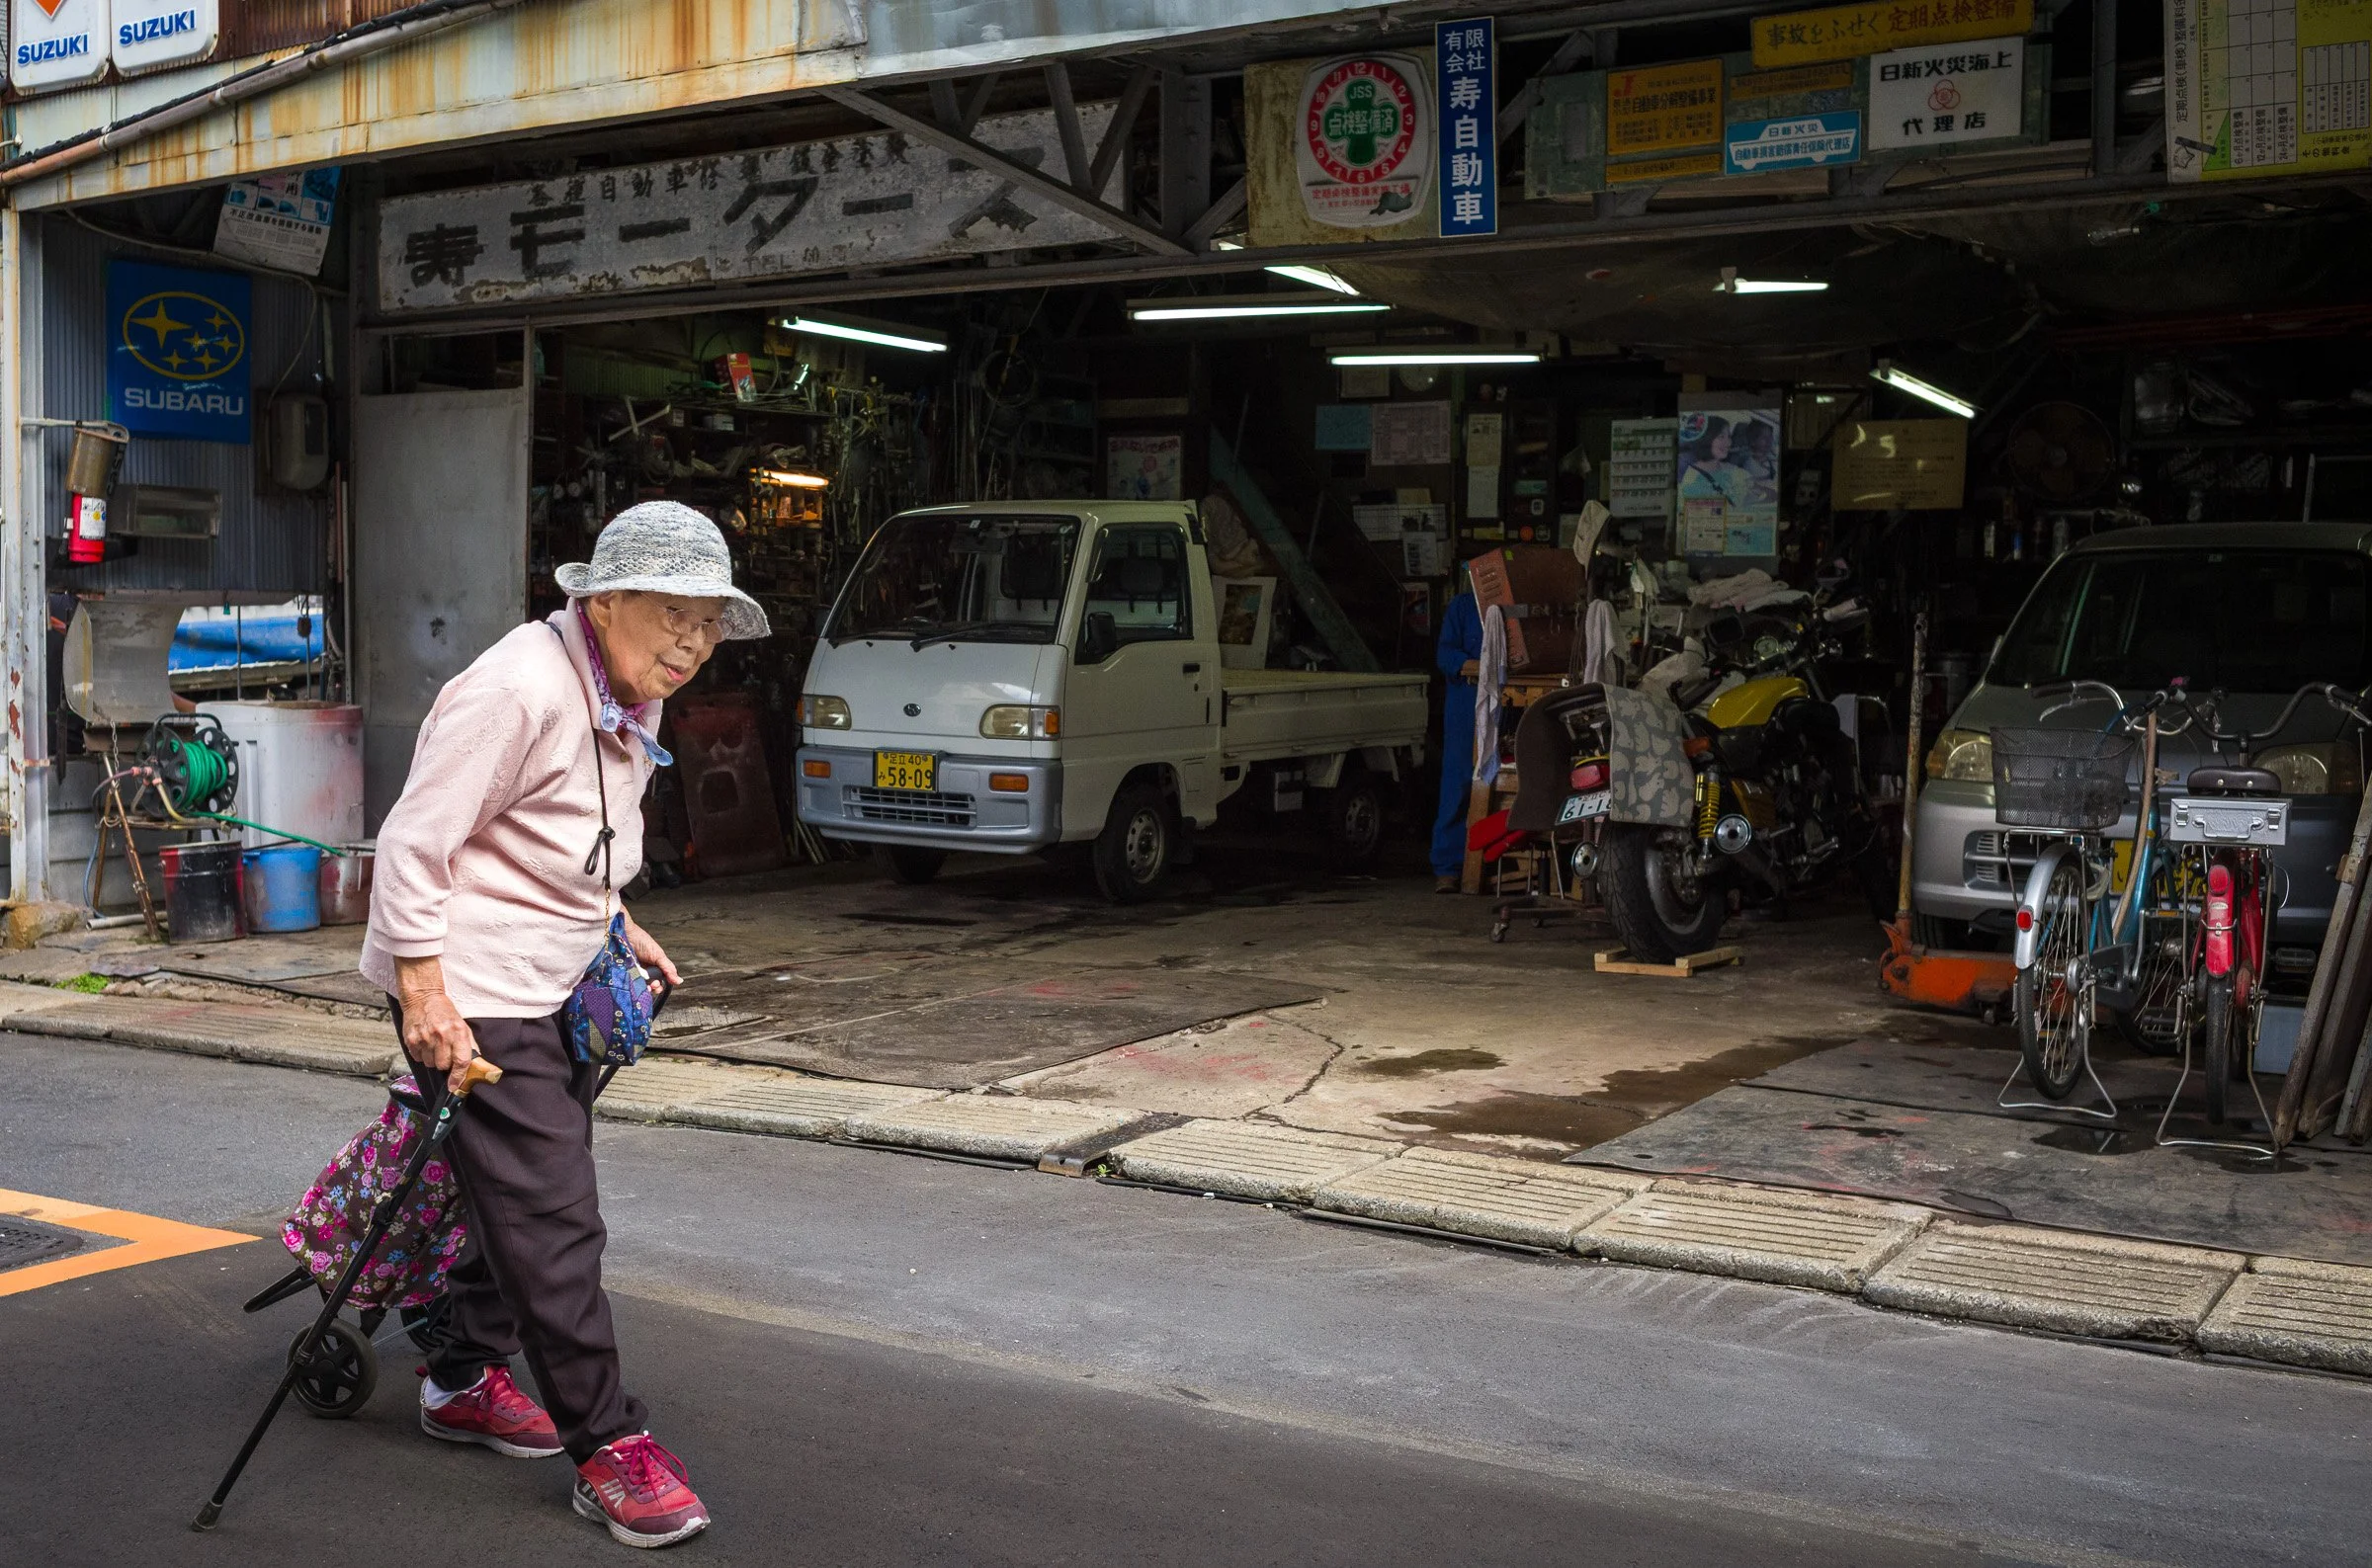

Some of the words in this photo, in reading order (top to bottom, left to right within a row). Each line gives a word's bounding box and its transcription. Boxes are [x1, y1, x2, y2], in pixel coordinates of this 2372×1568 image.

[1888, 0, 2016, 34] 定期点検整備
[119, 9, 197, 46] SUZUKI
[1444, 28, 1485, 51] 有限
[17, 33, 90, 65] SUZUKI
[1355, 62, 1366, 74] 12
[1446, 50, 1486, 74] 会社
[1880, 50, 2013, 82] 日新火災海上
[1382, 66, 1388, 78] 1
[1350, 85, 1373, 99] JSS
[1398, 85, 1407, 98] 2
[1311, 119, 1317, 131] 9
[1328, 108, 1395, 135] 点検整備済
[1405, 114, 1413, 126] 3
[1902, 111, 1987, 135] 代理店
[1768, 124, 1819, 137] 日新火災
[1316, 146, 1324, 159] 8
[1398, 142, 1406, 153] 4
[1449, 76, 1485, 226] 寿自動車
[1357, 171, 1365, 182] 6
[1381, 163, 1390, 174] 5
[404, 146, 1044, 288] 寿モータース
[124, 387, 245, 416] SUBARU
[889, 753, 906, 766] 足立
[907, 754, 923, 766] 40
[888, 766, 934, 789] 58-09
